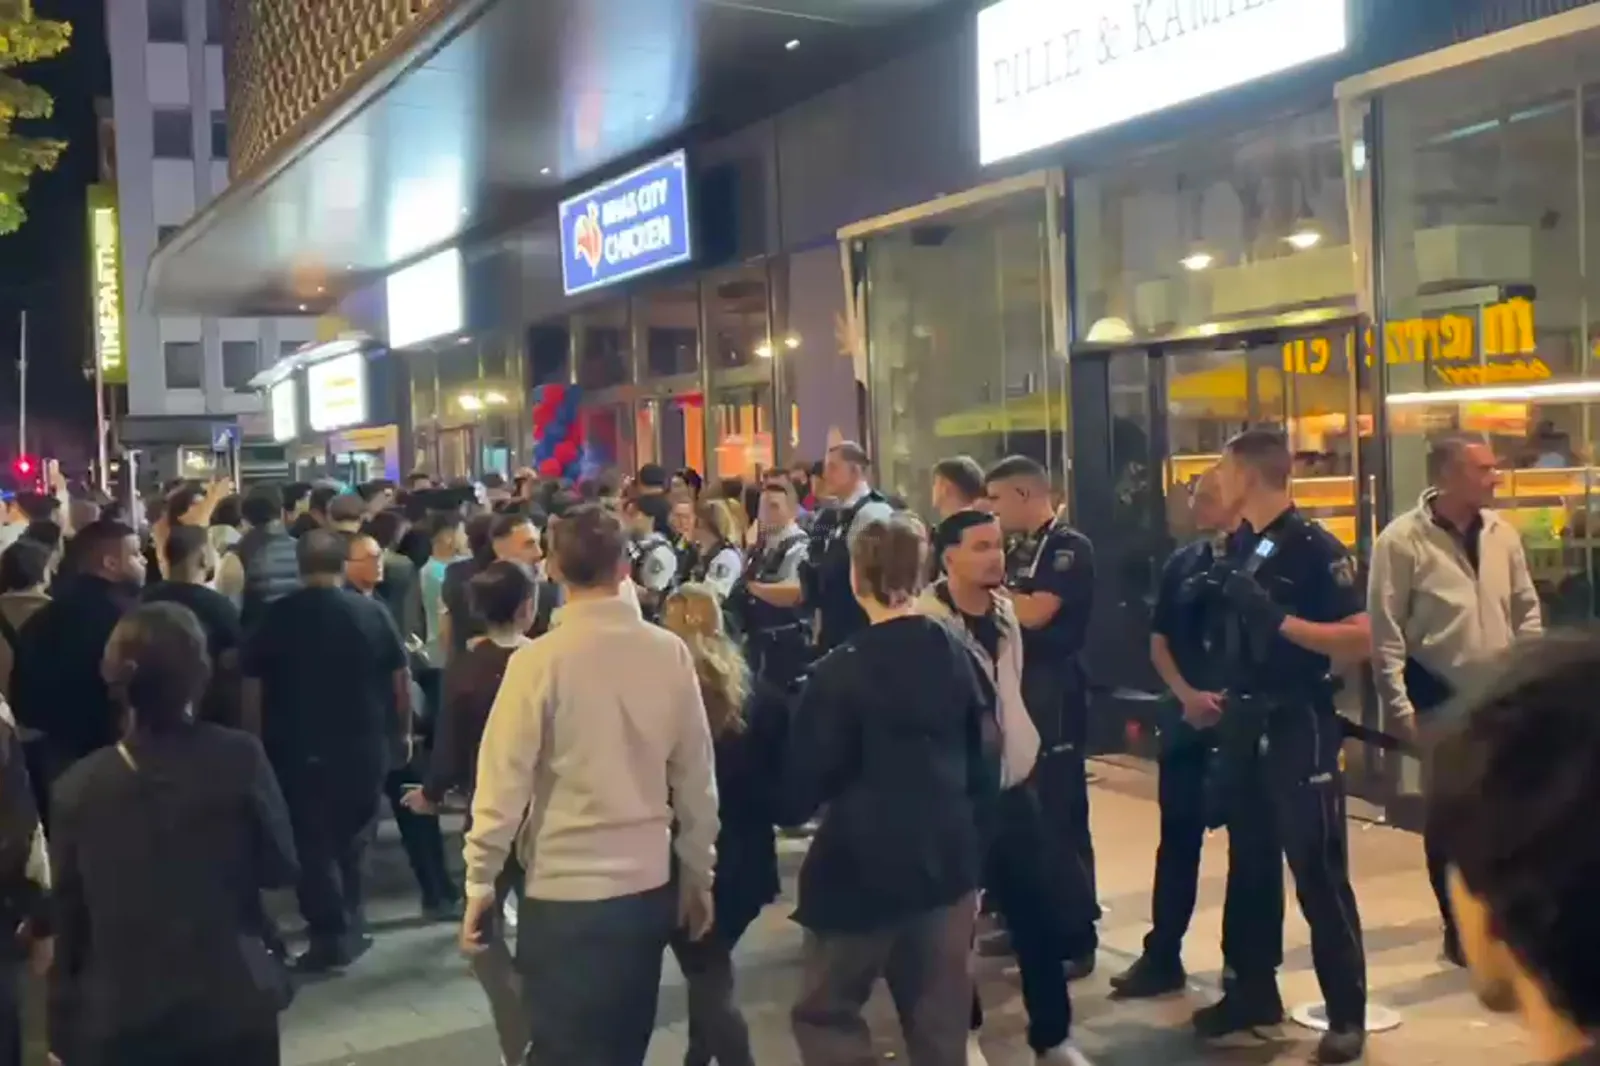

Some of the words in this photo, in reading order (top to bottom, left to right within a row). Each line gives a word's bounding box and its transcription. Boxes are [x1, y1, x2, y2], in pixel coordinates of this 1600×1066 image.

[994, 29, 1082, 104] DILLE
[1097, 15, 1121, 65] &
[638, 178, 667, 212] CITY
[604, 214, 671, 265] CHICKEN
